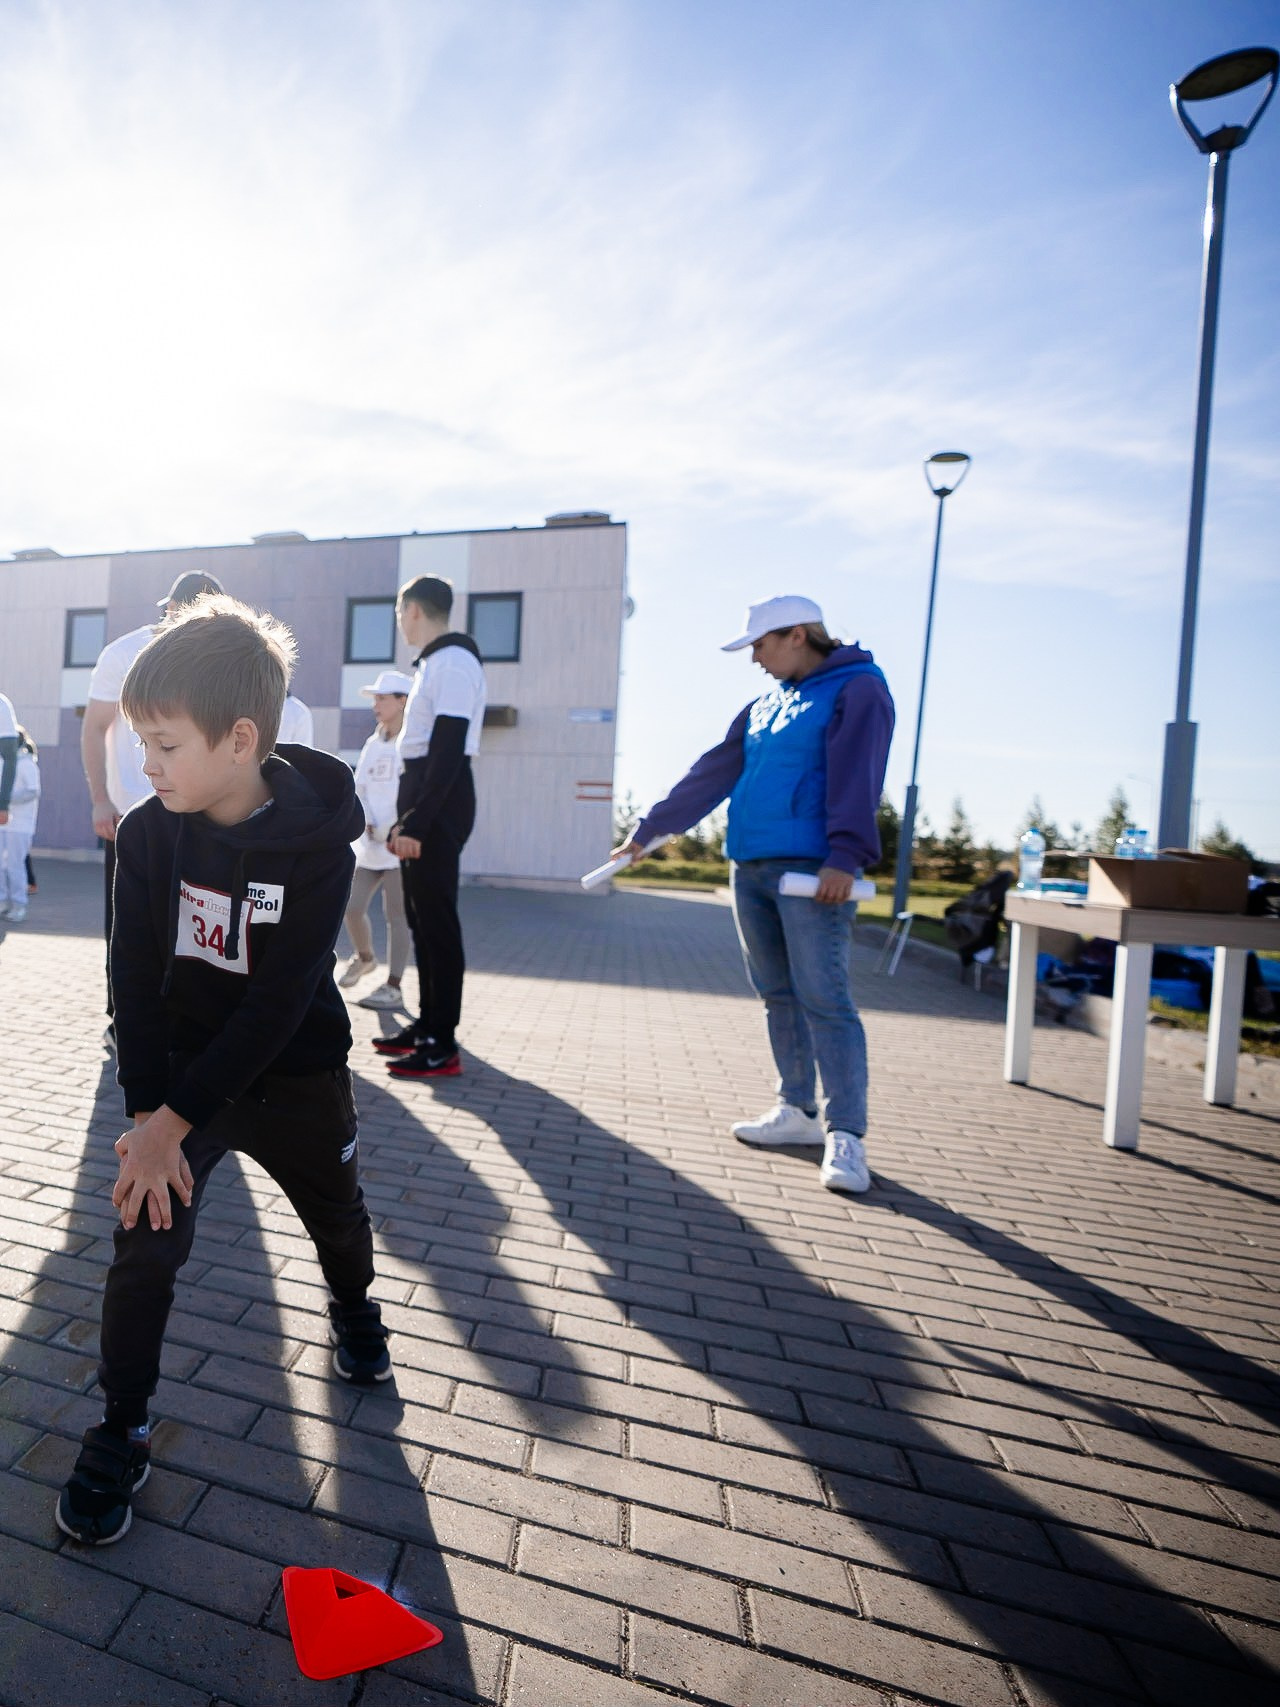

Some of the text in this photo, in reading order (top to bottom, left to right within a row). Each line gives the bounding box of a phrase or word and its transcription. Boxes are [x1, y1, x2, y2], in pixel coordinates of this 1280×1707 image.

[248, 887, 266, 899] me
[254, 899, 279, 911] ool
[192, 914, 225, 957] 34
